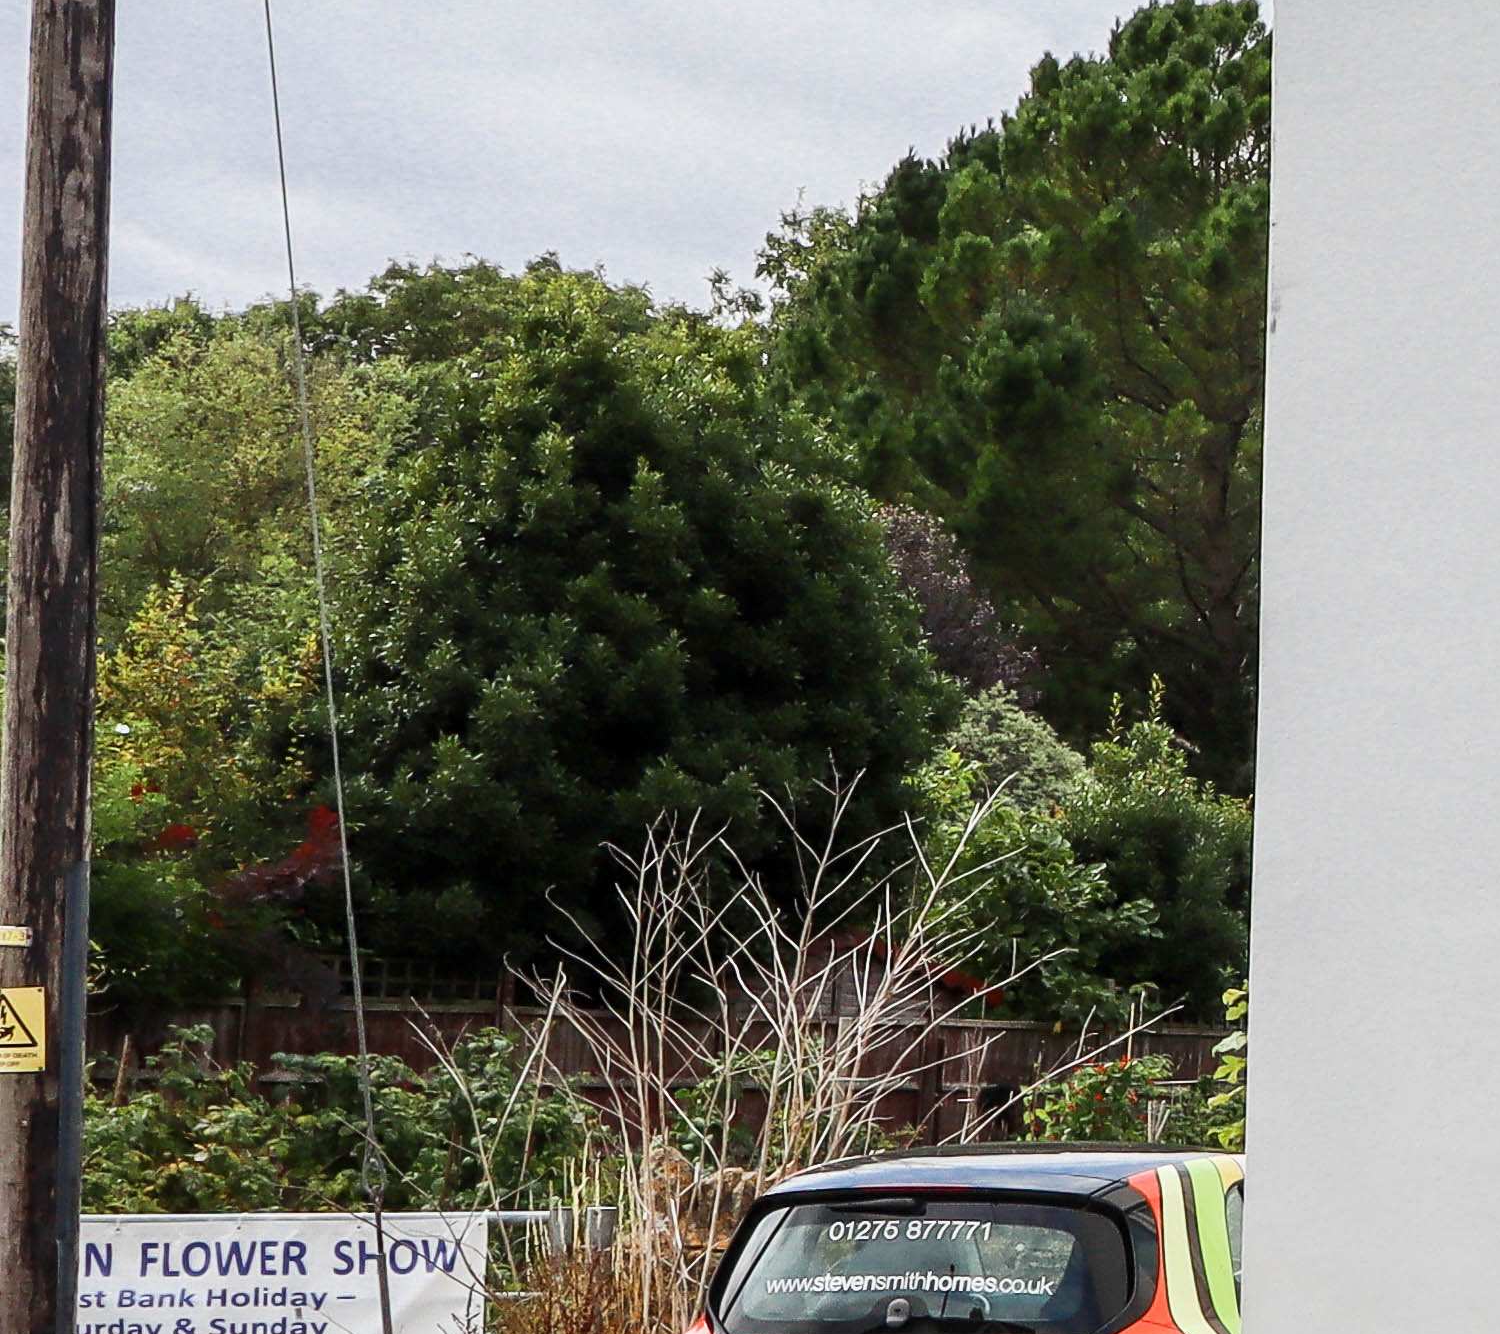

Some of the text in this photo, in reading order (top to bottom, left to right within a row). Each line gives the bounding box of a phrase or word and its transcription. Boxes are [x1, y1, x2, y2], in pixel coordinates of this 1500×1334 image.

[828, 1220, 993, 1242] 01275 877771
[139, 1240, 308, 1278] FLOWER
[333, 1238, 460, 1276] SHOW
[766, 1271, 1055, 1296] www.stevensmithhomes.co.uk
[117, 1288, 196, 1308] Bank
[206, 1287, 328, 1312] Holiday
